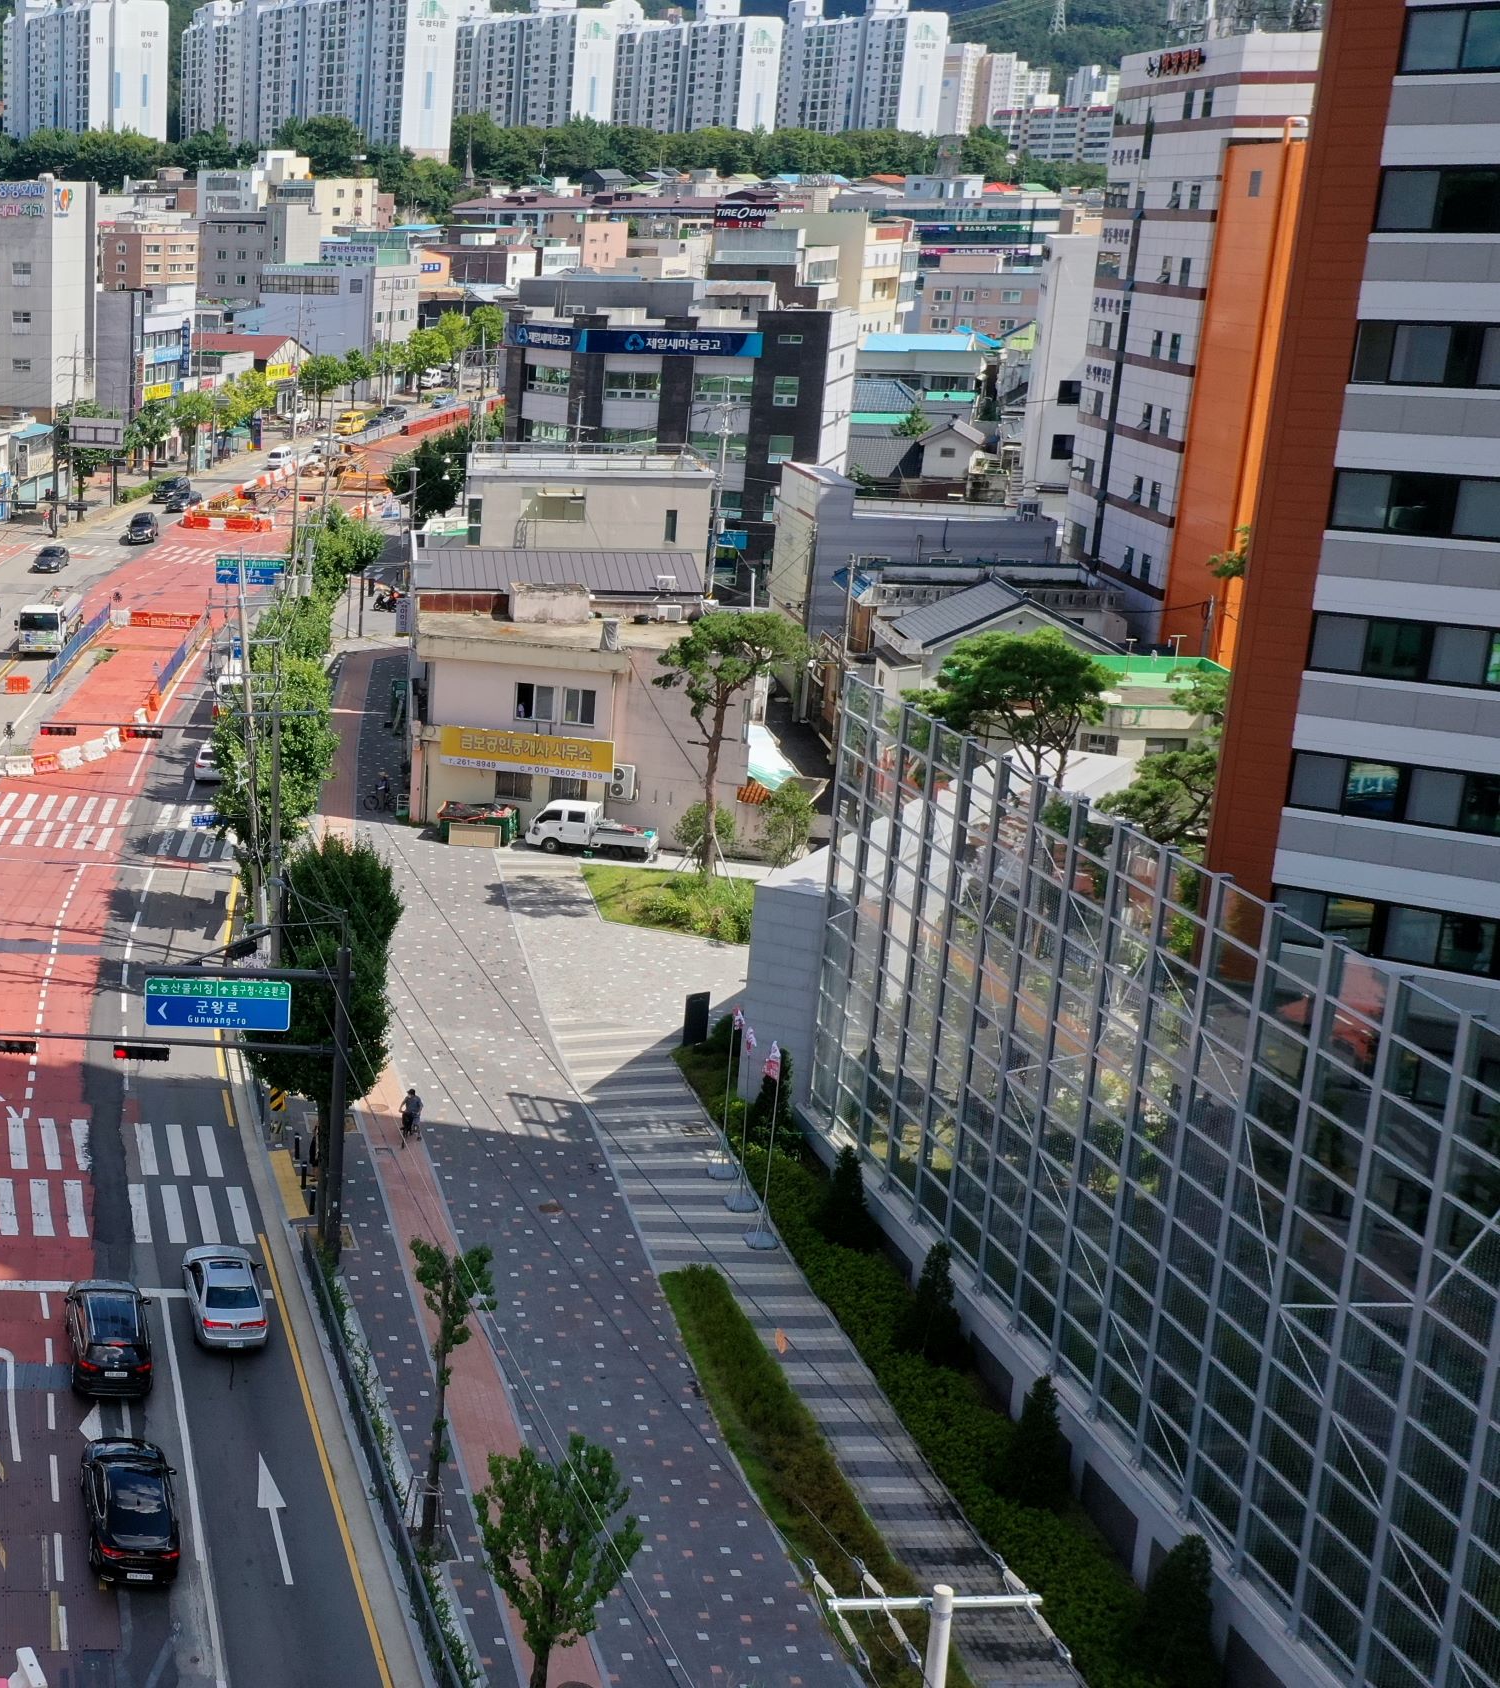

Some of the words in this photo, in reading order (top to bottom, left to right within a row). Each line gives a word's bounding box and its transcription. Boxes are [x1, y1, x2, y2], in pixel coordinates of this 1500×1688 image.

[717, 209, 737, 217] TIRE
[528, 331, 570, 346] 제일새마을금고
[646, 337, 721, 352] 제일새마을금고
[460, 734, 550, 759] 금보공인중개사
[553, 744, 593, 762] 사무소
[534, 766, 603, 780] 010-3602-8309
[160, 982, 215, 996] 농산물시장
[196, 1001, 239, 1015] 군왕로
[187, 1014, 246, 1027] Gunwang-ro
